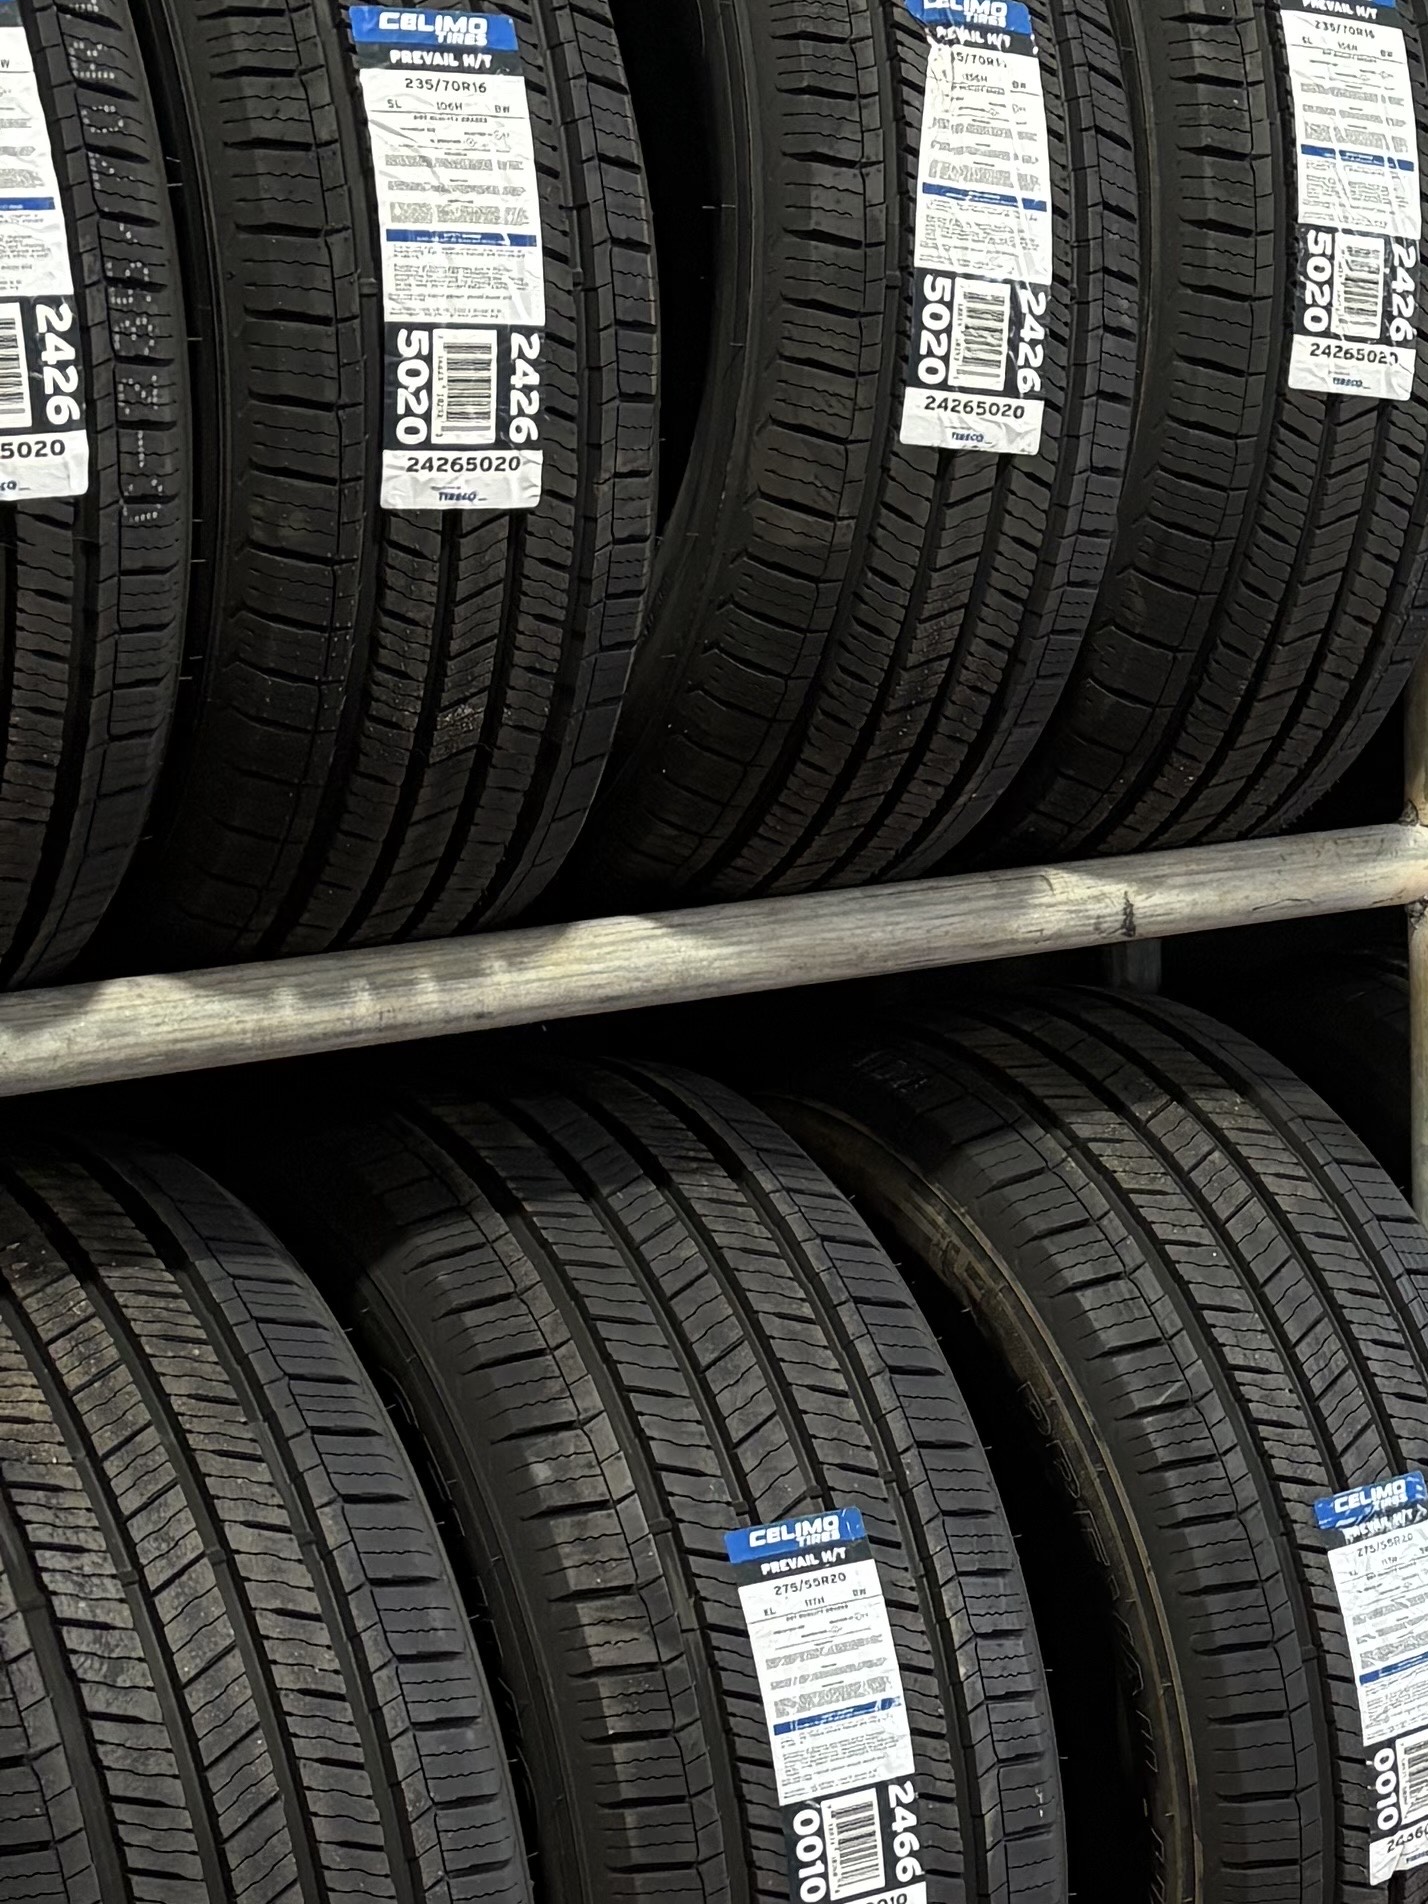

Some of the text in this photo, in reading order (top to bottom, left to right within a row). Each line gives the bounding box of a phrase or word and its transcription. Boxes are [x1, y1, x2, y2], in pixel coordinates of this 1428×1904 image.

[390, 50, 493, 69] PREVAIL H/T
[436, 33, 488, 46] TIRES
[404, 77, 487, 94] 235/70R16
[1303, 230, 1333, 333] 5020
[1389, 243, 1417, 342] 2426
[918, 273, 952, 386] 5020
[1016, 286, 1047, 393] 2426
[35, 304, 80, 426] 2426
[396, 328, 429, 445] 5020
[509, 332, 542, 444] 2426
[924, 395, 1025, 418] 24265020
[0, 439, 66, 458] 5020
[406, 455, 521, 473] 24265020
[1334, 1479, 1407, 1512] CELIMO
[761, 1547, 847, 1576] PREVAIL H/T
[797, 1528, 841, 1548] TIRES
[774, 1572, 847, 1595] 275/55R20
[1373, 1748, 1398, 1831] 0010
[793, 1809, 827, 1903] 0010
[888, 1781, 924, 1883] 2466
